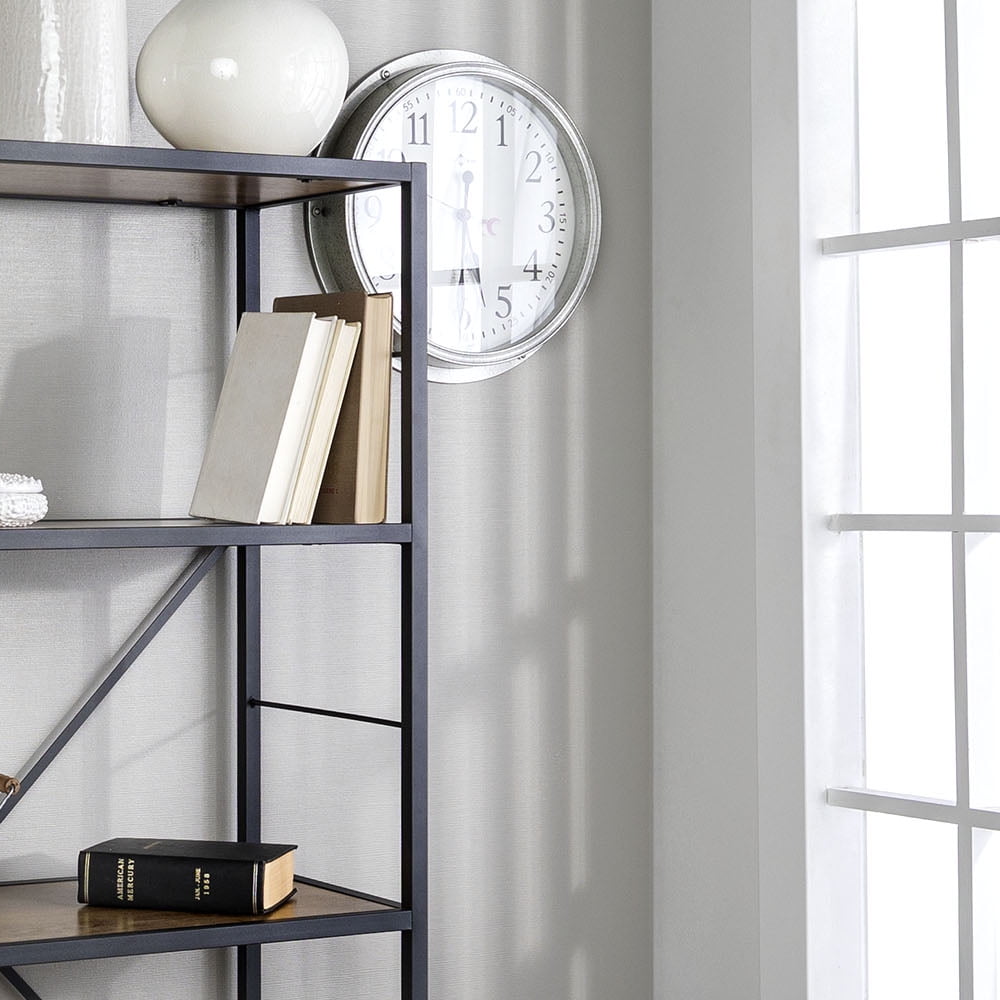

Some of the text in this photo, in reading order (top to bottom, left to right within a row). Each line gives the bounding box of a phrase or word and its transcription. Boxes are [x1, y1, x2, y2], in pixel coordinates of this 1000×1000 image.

[403, 100, 413, 112] 55
[448, 100, 478, 133] 12
[506, 105, 516, 117] 05
[407, 112, 431, 145] 11
[495, 114, 509, 147] 1
[525, 151, 542, 183] 2
[364, 195, 382, 231] 9
[538, 200, 556, 233] 3
[559, 213, 567, 224] 15
[522, 249, 543, 281] 4
[545, 270, 555, 284] 20
[495, 284, 512, 319] 5
[116, 858, 125, 901] AMERICAN
[127, 858, 135, 902] MERCURY
